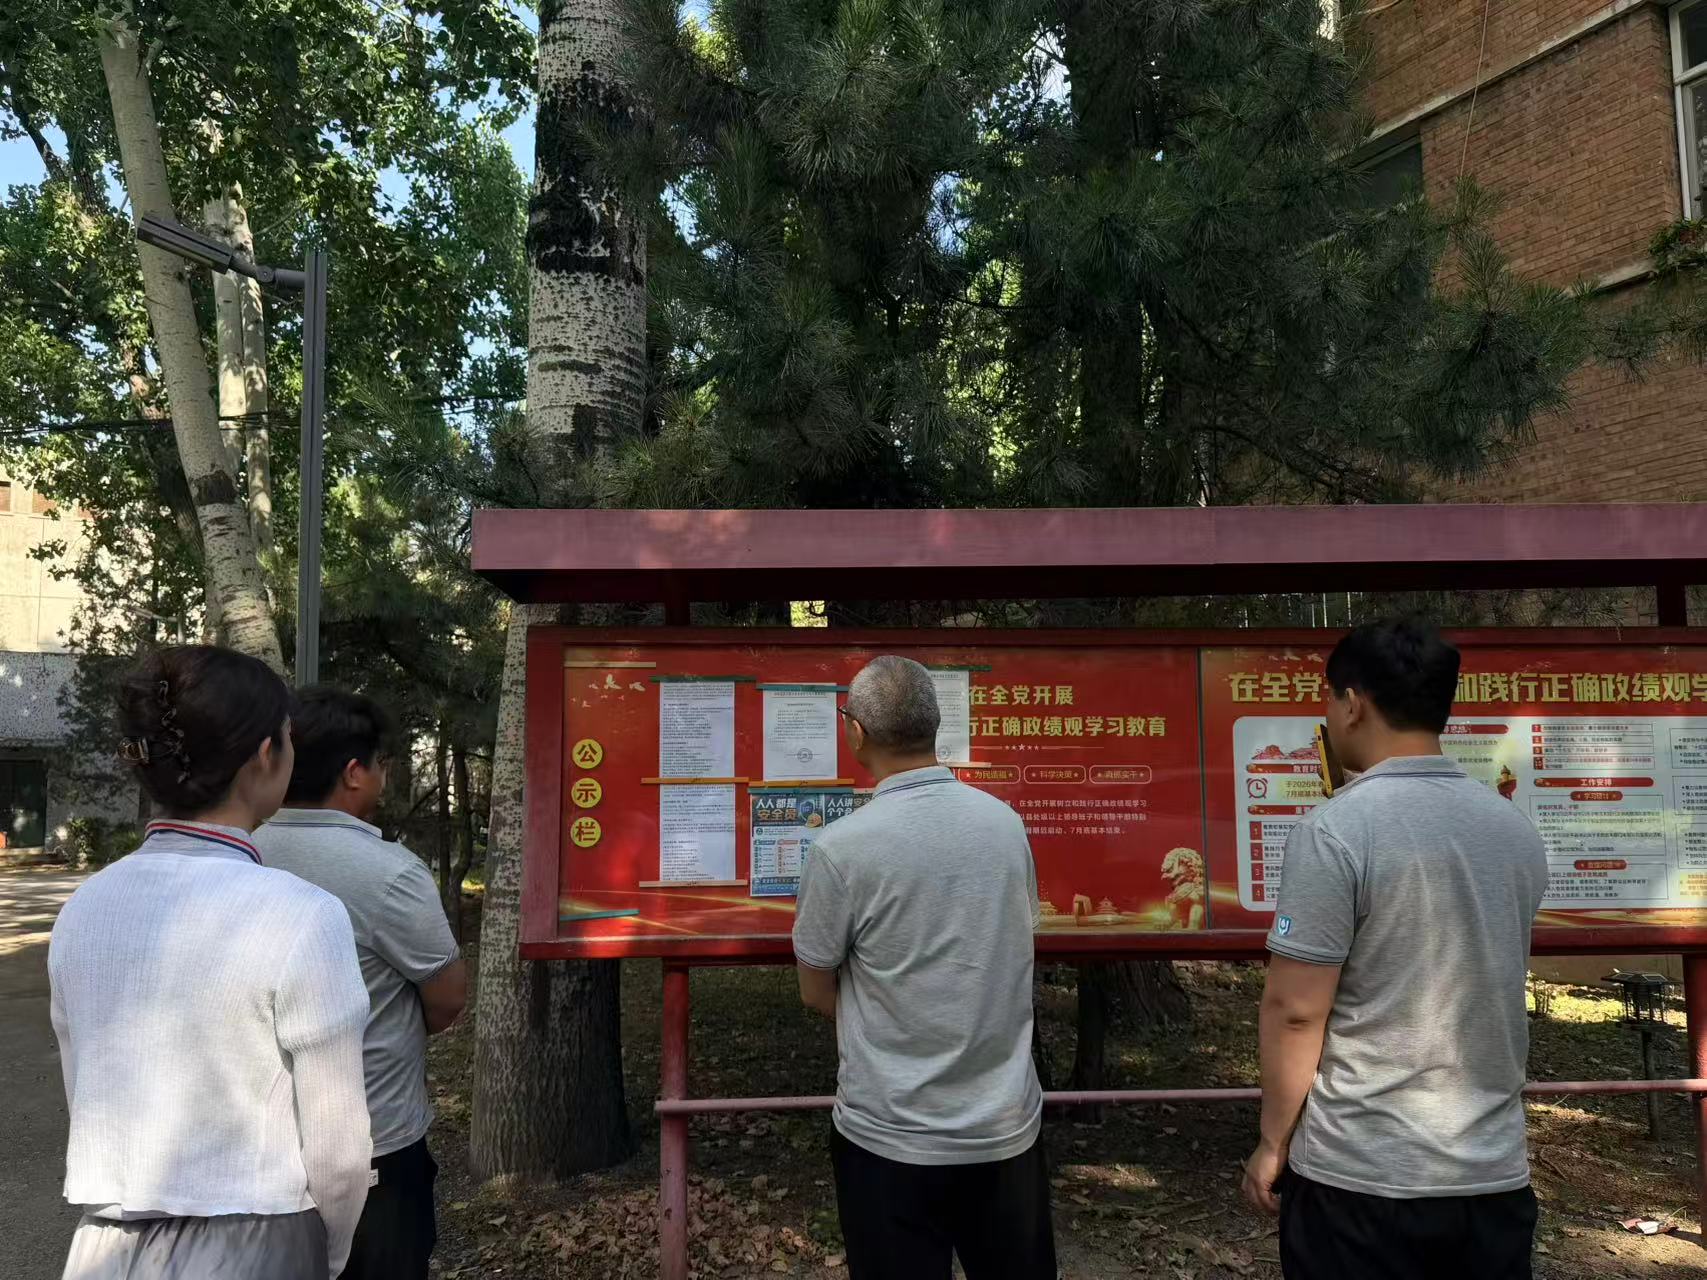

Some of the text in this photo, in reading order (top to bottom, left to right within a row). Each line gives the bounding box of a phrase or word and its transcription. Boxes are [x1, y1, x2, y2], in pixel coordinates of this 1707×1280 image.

[1228, 672, 1328, 702] 在全党
[969, 685, 1074, 706] 在全党开展
[1293, 765, 1320, 774] 教育时
[574, 743, 599, 842] 公示栏
[756, 798, 797, 809] 人人都是
[758, 809, 797, 821] 安全员
